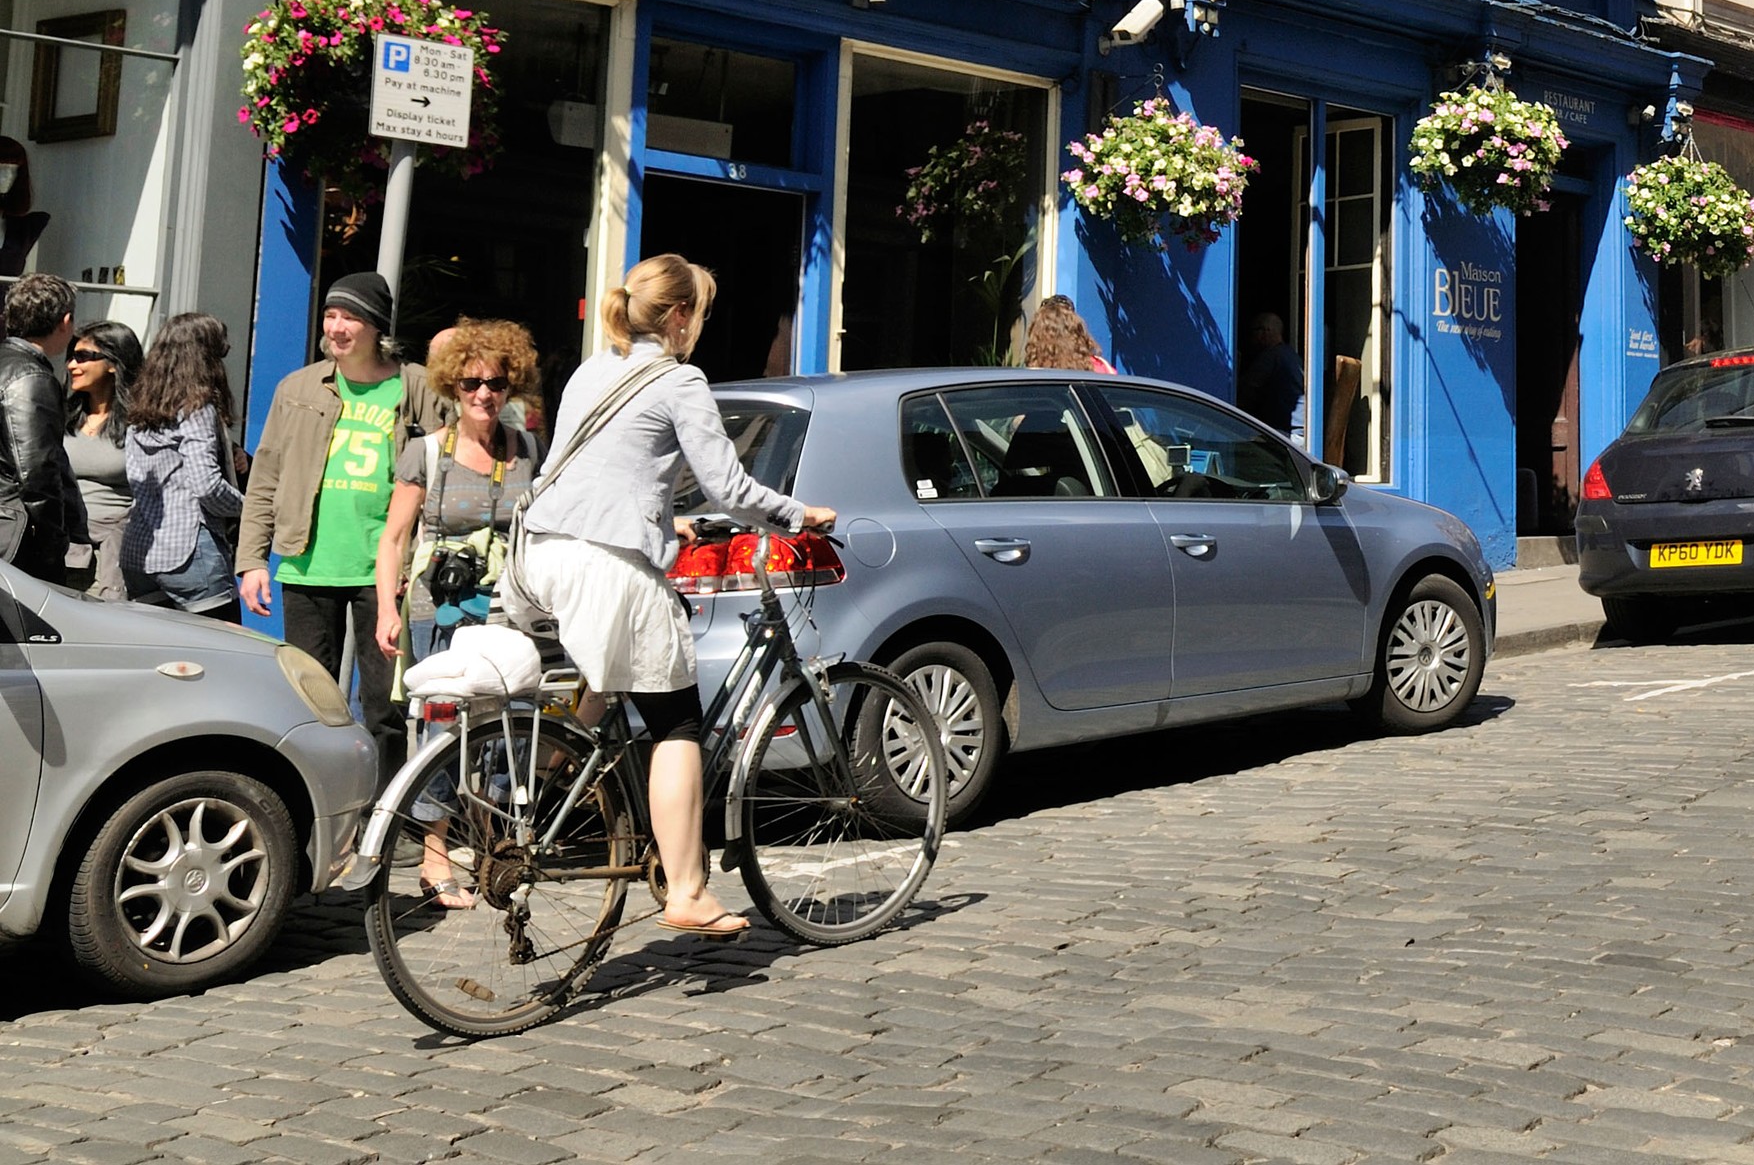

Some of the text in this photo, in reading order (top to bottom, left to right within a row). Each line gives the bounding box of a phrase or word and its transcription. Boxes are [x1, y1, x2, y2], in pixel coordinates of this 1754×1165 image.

[388, 44, 408, 69] P
[414, 55, 439, 67] 8.30
[440, 62, 455, 70] am
[420, 45, 442, 56] Mon
[450, 49, 468, 61] Sat
[423, 68, 465, 83] 6.30 pm
[384, 77, 462, 97] Pay at machine
[1543, 90, 1596, 114] RESTAURANT
[386, 108, 456, 127] Display ticket
[376, 122, 464, 142] Max stay 4 hours
[729, 163, 746, 179] 38
[1460, 261, 1502, 284] Maison
[1436, 320, 1450, 333] The
[328, 429, 382, 477] 75
[335, 479, 348, 490] CA
[1658, 540, 1735, 562] KP60 YDK
[29, 634, 58, 642] GLS
